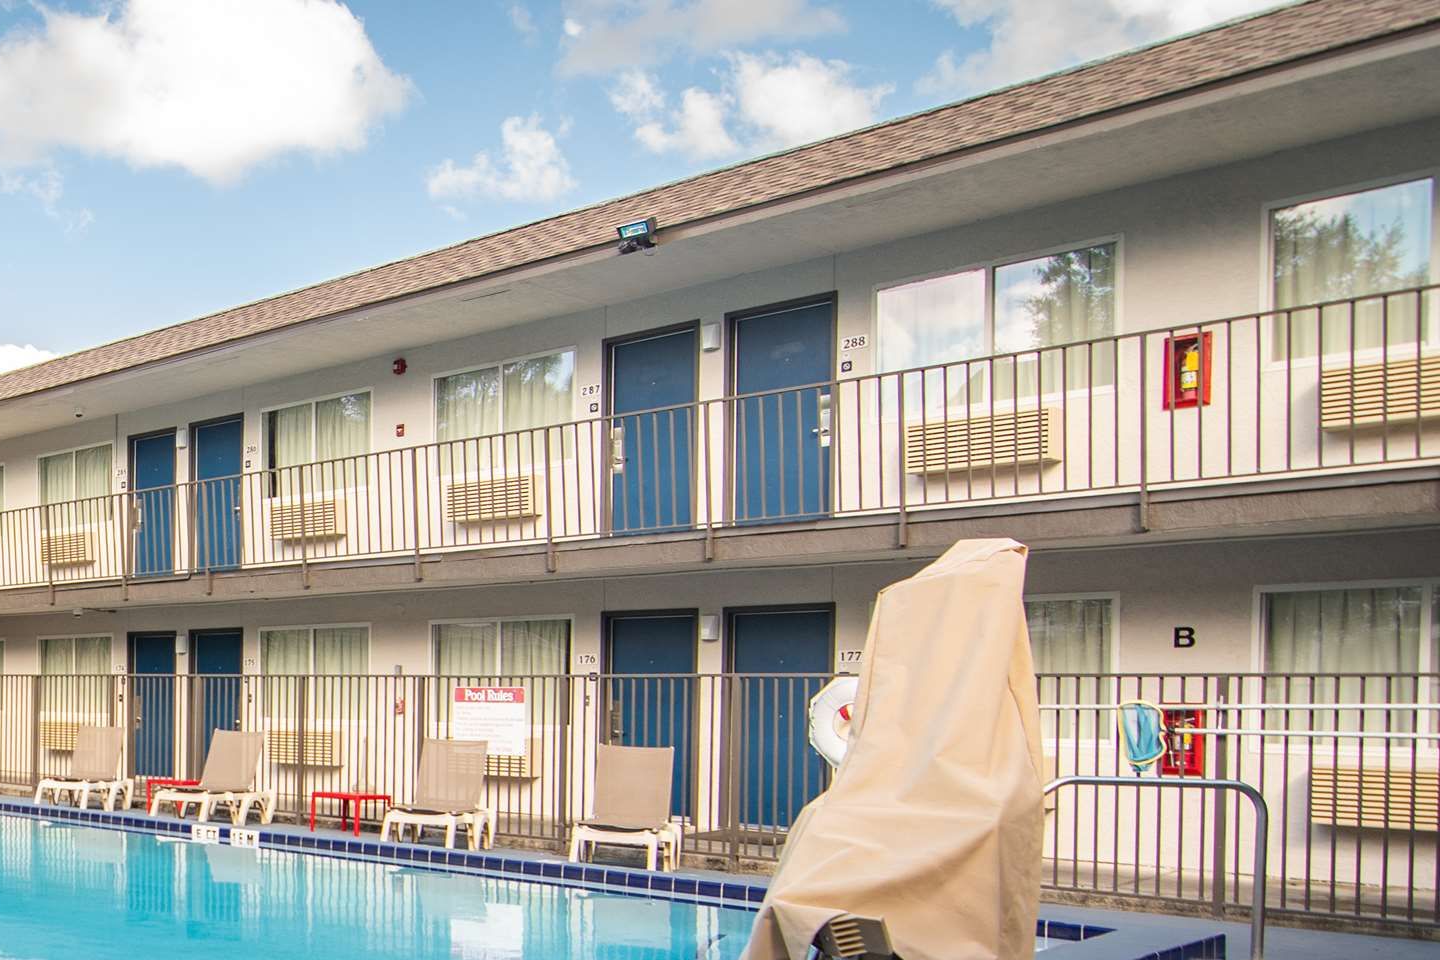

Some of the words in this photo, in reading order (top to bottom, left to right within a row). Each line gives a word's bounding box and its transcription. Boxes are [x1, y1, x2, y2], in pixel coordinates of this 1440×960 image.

[843, 336, 865, 349] 288
[582, 384, 600, 396] 287
[1174, 627, 1195, 648] B
[579, 654, 596, 664] 176
[841, 651, 862, 661] 177
[464, 689, 485, 701] Pool
[487, 689, 514, 701] Rules
